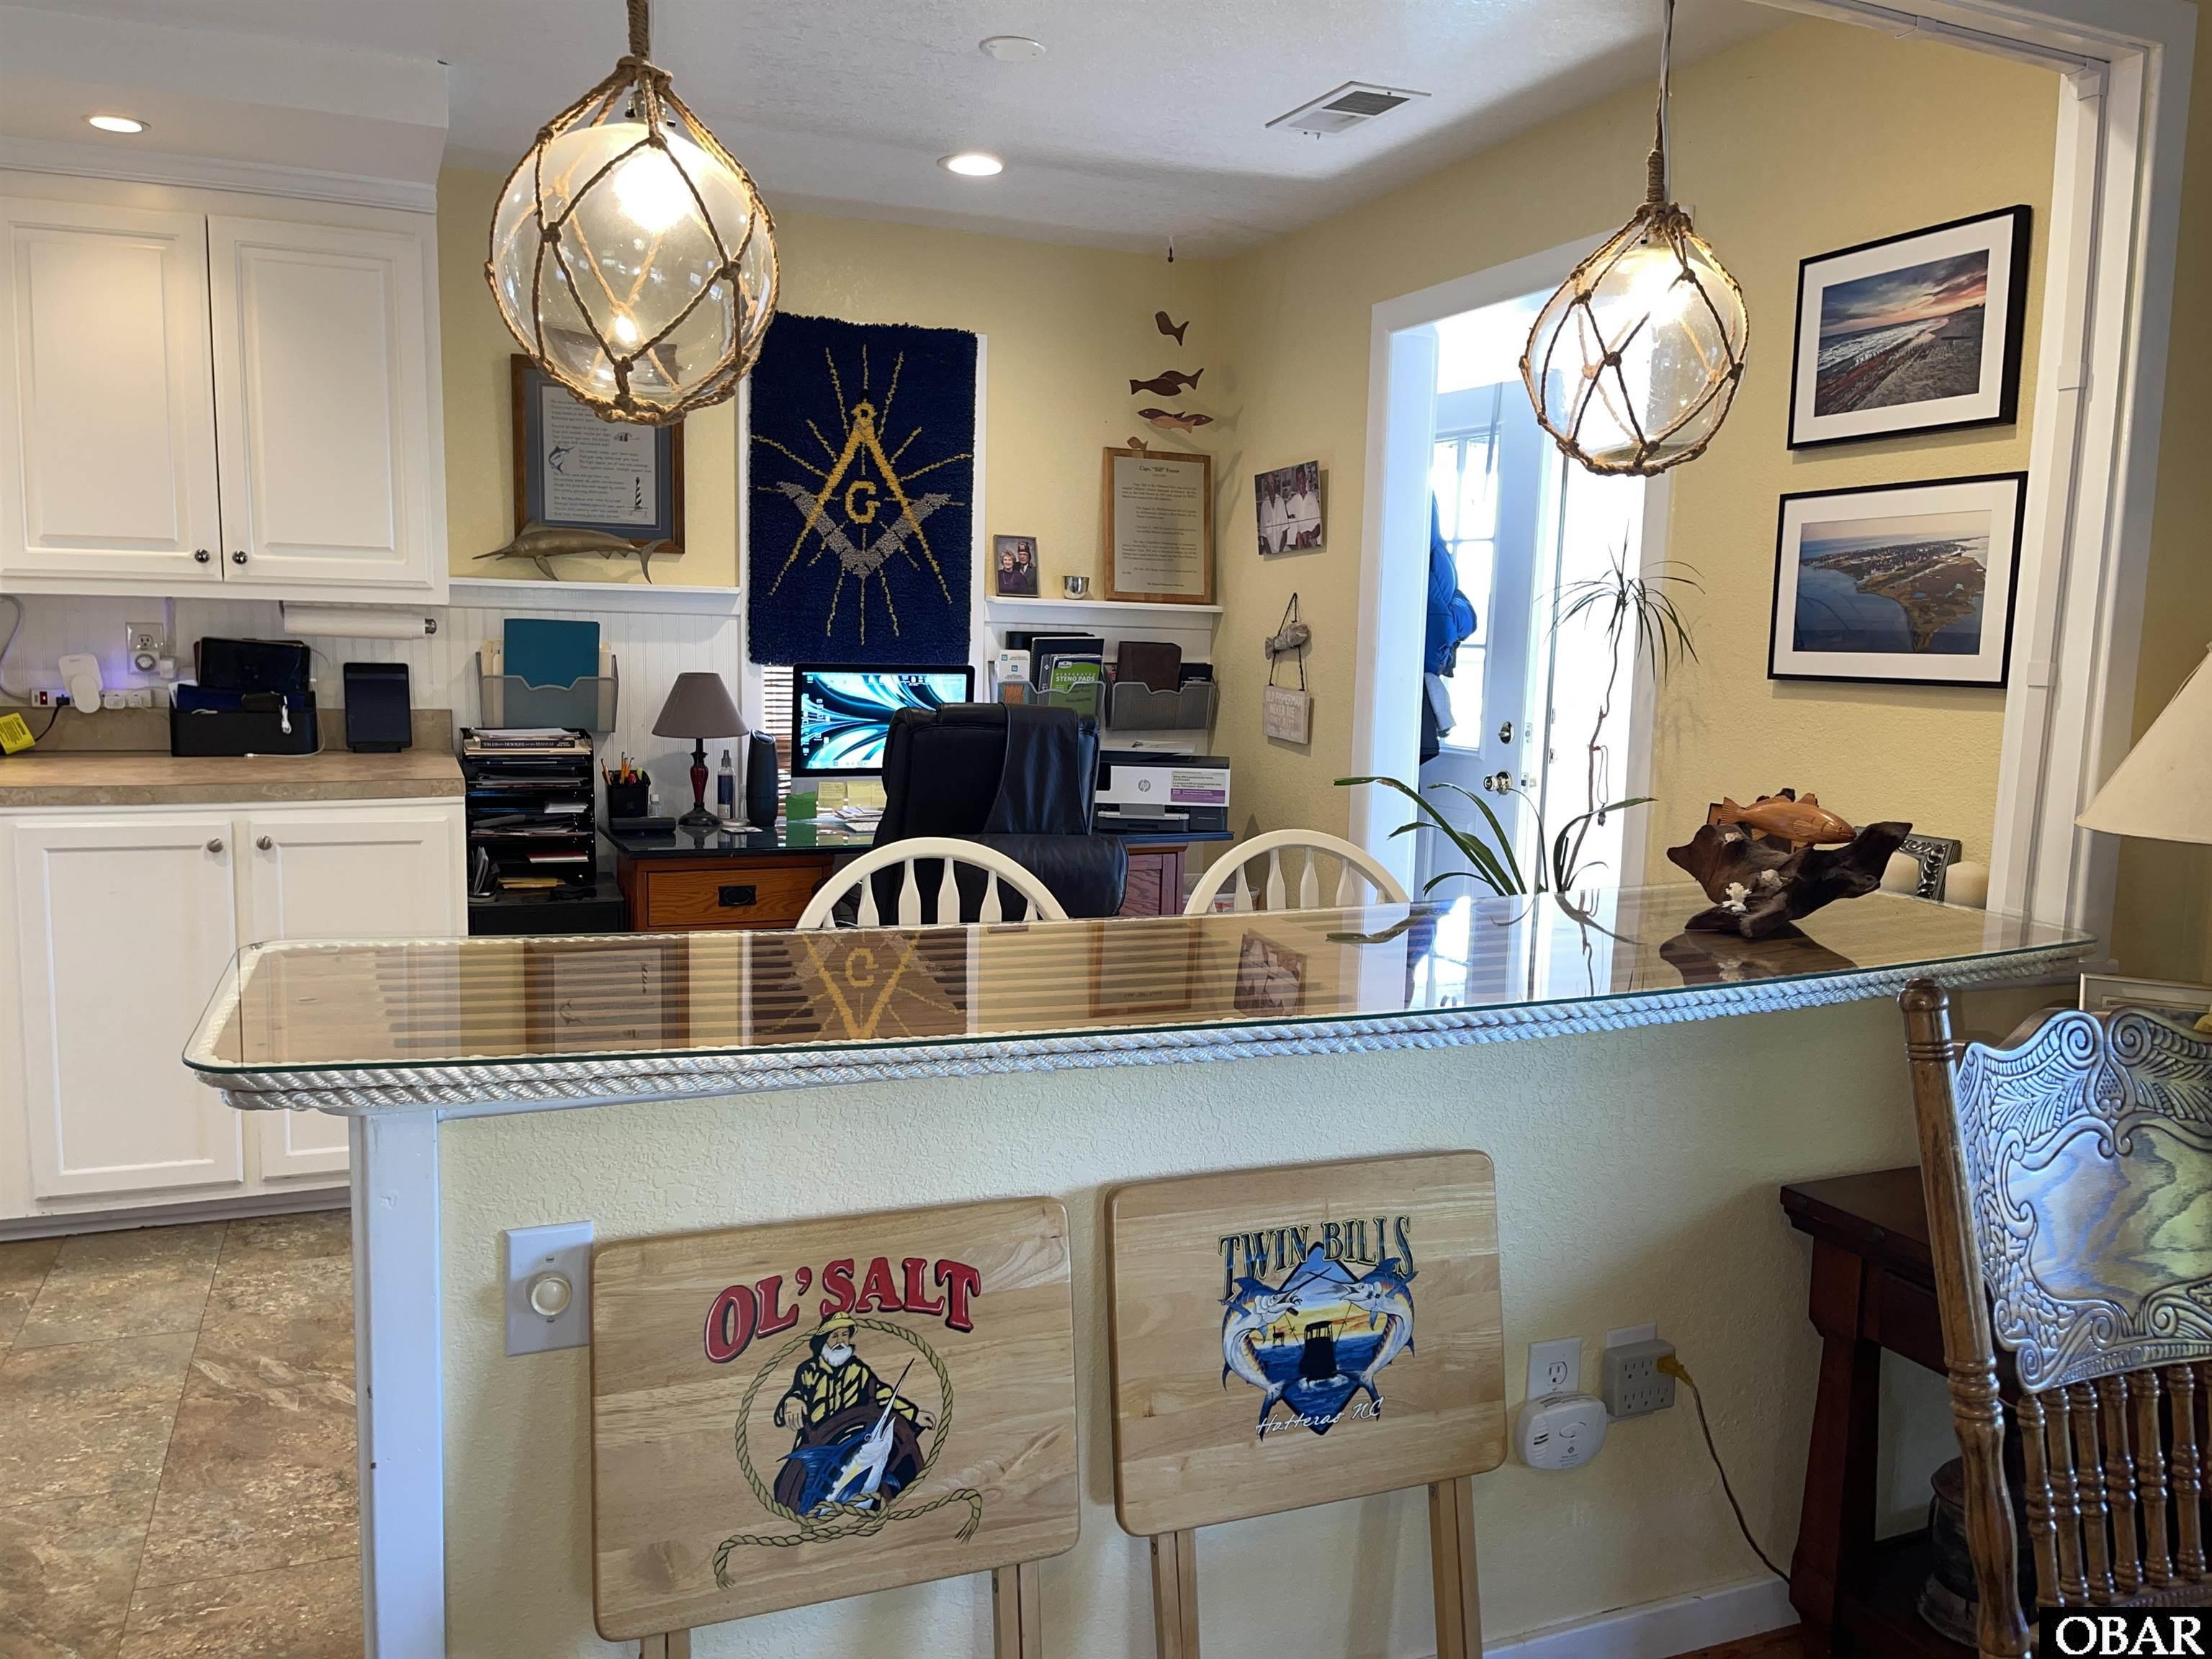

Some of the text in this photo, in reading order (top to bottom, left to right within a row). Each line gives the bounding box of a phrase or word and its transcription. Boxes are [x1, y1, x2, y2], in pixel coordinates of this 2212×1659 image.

[845, 480, 881, 524] G
[1138, 778, 1151, 792] hp
[1218, 1215, 1415, 1300] TWIN BILLS
[820, 1256, 981, 1334] SALT
[1256, 1397, 1384, 1435] Hatteras NC
